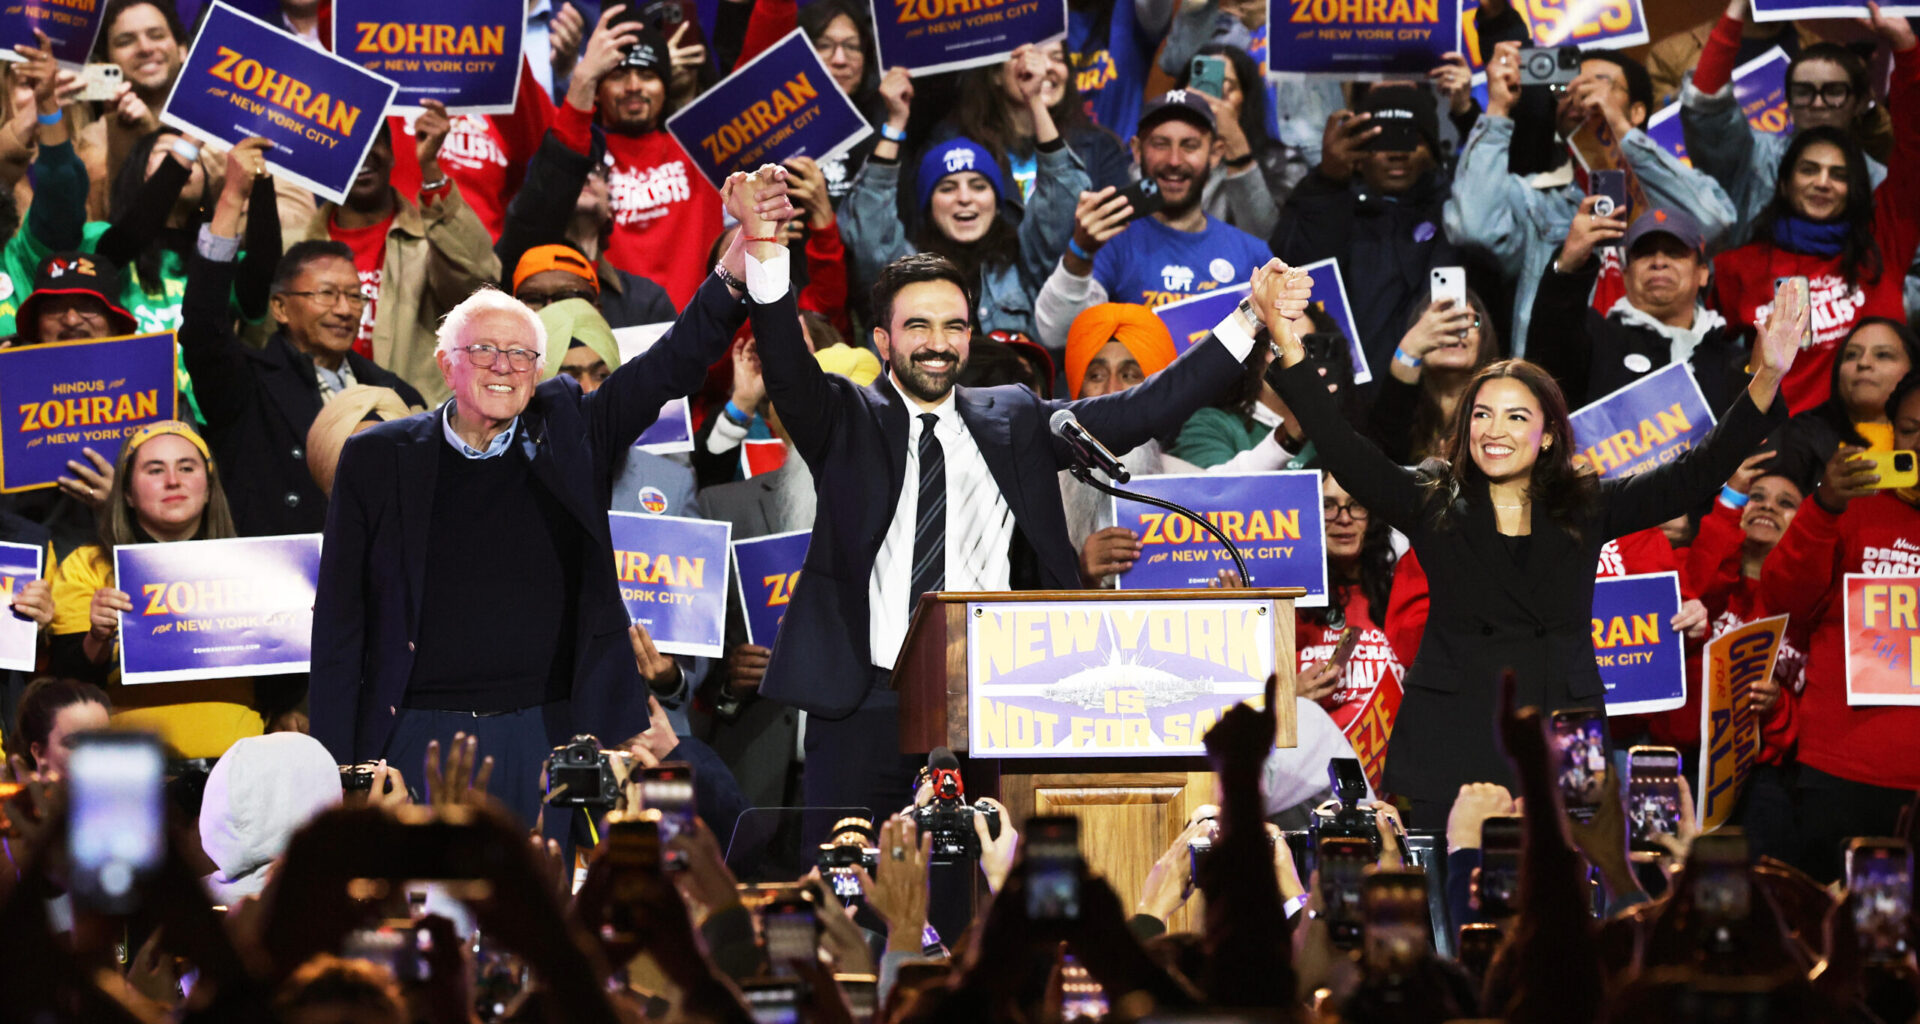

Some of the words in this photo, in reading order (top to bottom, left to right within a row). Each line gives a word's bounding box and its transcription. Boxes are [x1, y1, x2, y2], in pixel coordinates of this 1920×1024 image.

[25, 5, 50, 19] NEW
[927, 20, 962, 35] NEW
[966, 11, 1004, 28] YORK
[1006, 3, 1039, 19] CITY
[1289, 0, 1439, 24] ZOHRAN
[355, 22, 505, 55] ZOHRAN
[1318, 29, 1353, 41] NEW
[1356, 29, 1394, 41] YORK
[1398, 29, 1432, 41] CITY
[384, 59, 420, 72] NEW
[423, 60, 462, 73] YORK
[465, 60, 497, 73] CITY
[207, 45, 362, 137] ZOHRAN
[229, 92, 266, 116] NEW
[267, 107, 305, 135] YORK
[304, 127, 340, 149] CITY
[700, 71, 819, 166] ZOHRAN
[763, 124, 795, 149] YORK
[793, 104, 821, 129] CITY
[1164, 276, 1192, 291] UFT
[52, 380, 105, 394] HINDUS
[19, 389, 158, 433] ZOHRAN
[47, 431, 80, 445] NEW
[83, 428, 120, 442] YORK
[1572, 402, 1693, 476] HRAN
[1658, 439, 1691, 463] CITY
[1138, 509, 1302, 545] ZOHRAN
[1147, 552, 1168, 564] FOR
[1172, 550, 1208, 562] NEW
[1258, 546, 1294, 559] CITY
[658, 591, 695, 606] CITY
[152, 623, 173, 636] FOR
[176, 619, 213, 633] NEW
[216, 615, 258, 630] YORK
[978, 609, 1104, 686] NEW
[1109, 609, 1266, 683] YORK
[1618, 651, 1654, 666] CITY
[1872, 636, 1905, 670] THE
[1103, 690, 1147, 714] IS
[978, 696, 1059, 748] NOT
[1070, 715, 1151, 748] FOR
[1706, 707, 1733, 818] ALL
